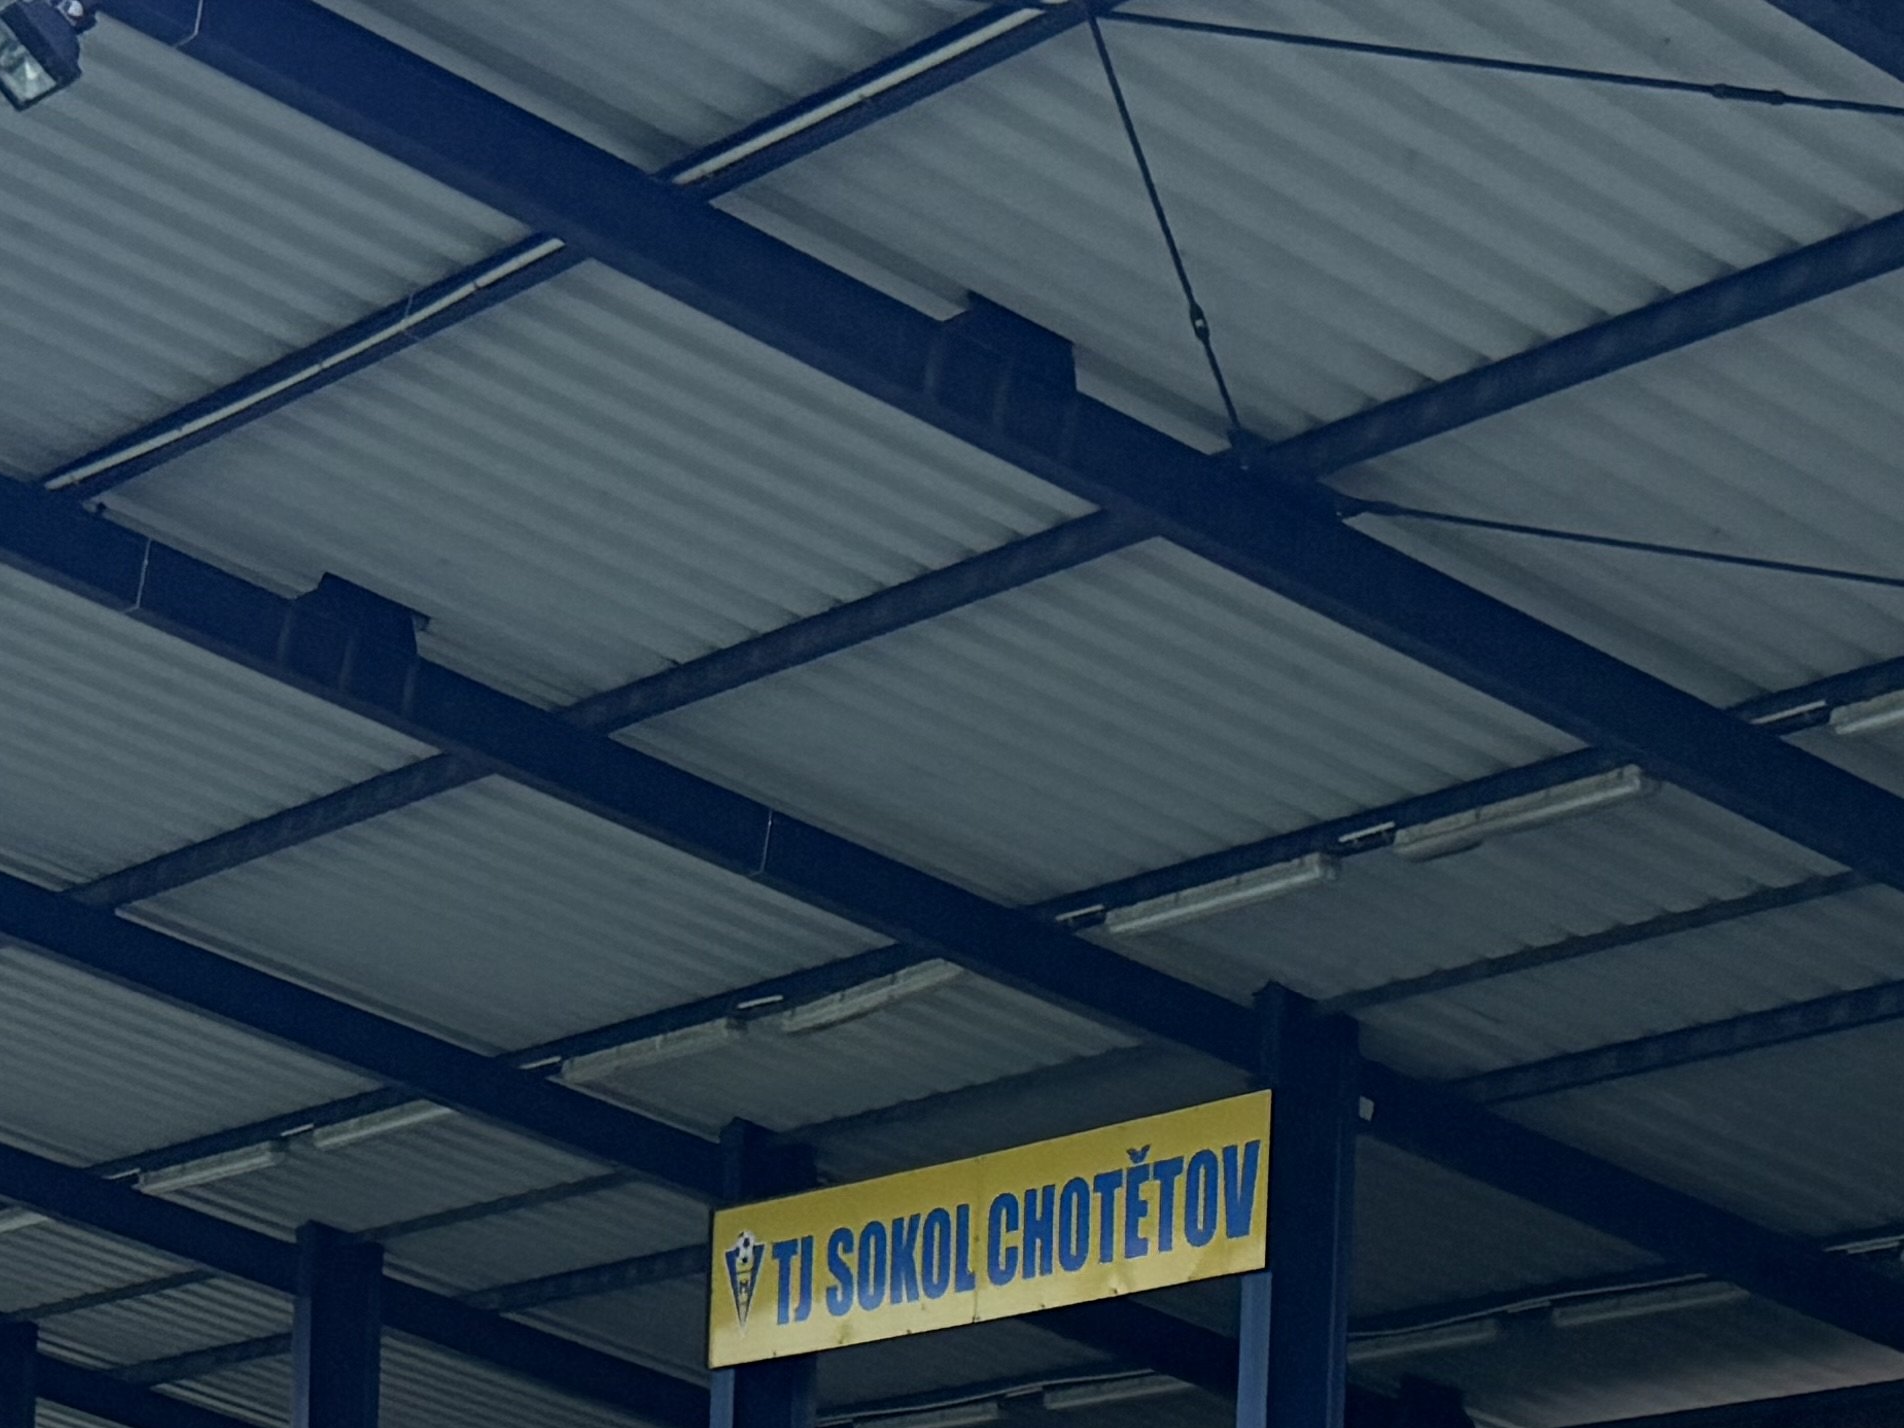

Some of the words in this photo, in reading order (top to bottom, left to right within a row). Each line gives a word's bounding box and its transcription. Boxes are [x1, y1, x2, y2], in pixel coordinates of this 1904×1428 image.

[771, 1234, 814, 1325] TJ
[825, 1203, 976, 1318] SOKOL
[987, 1139, 1262, 1288] CHOTĚTOV
